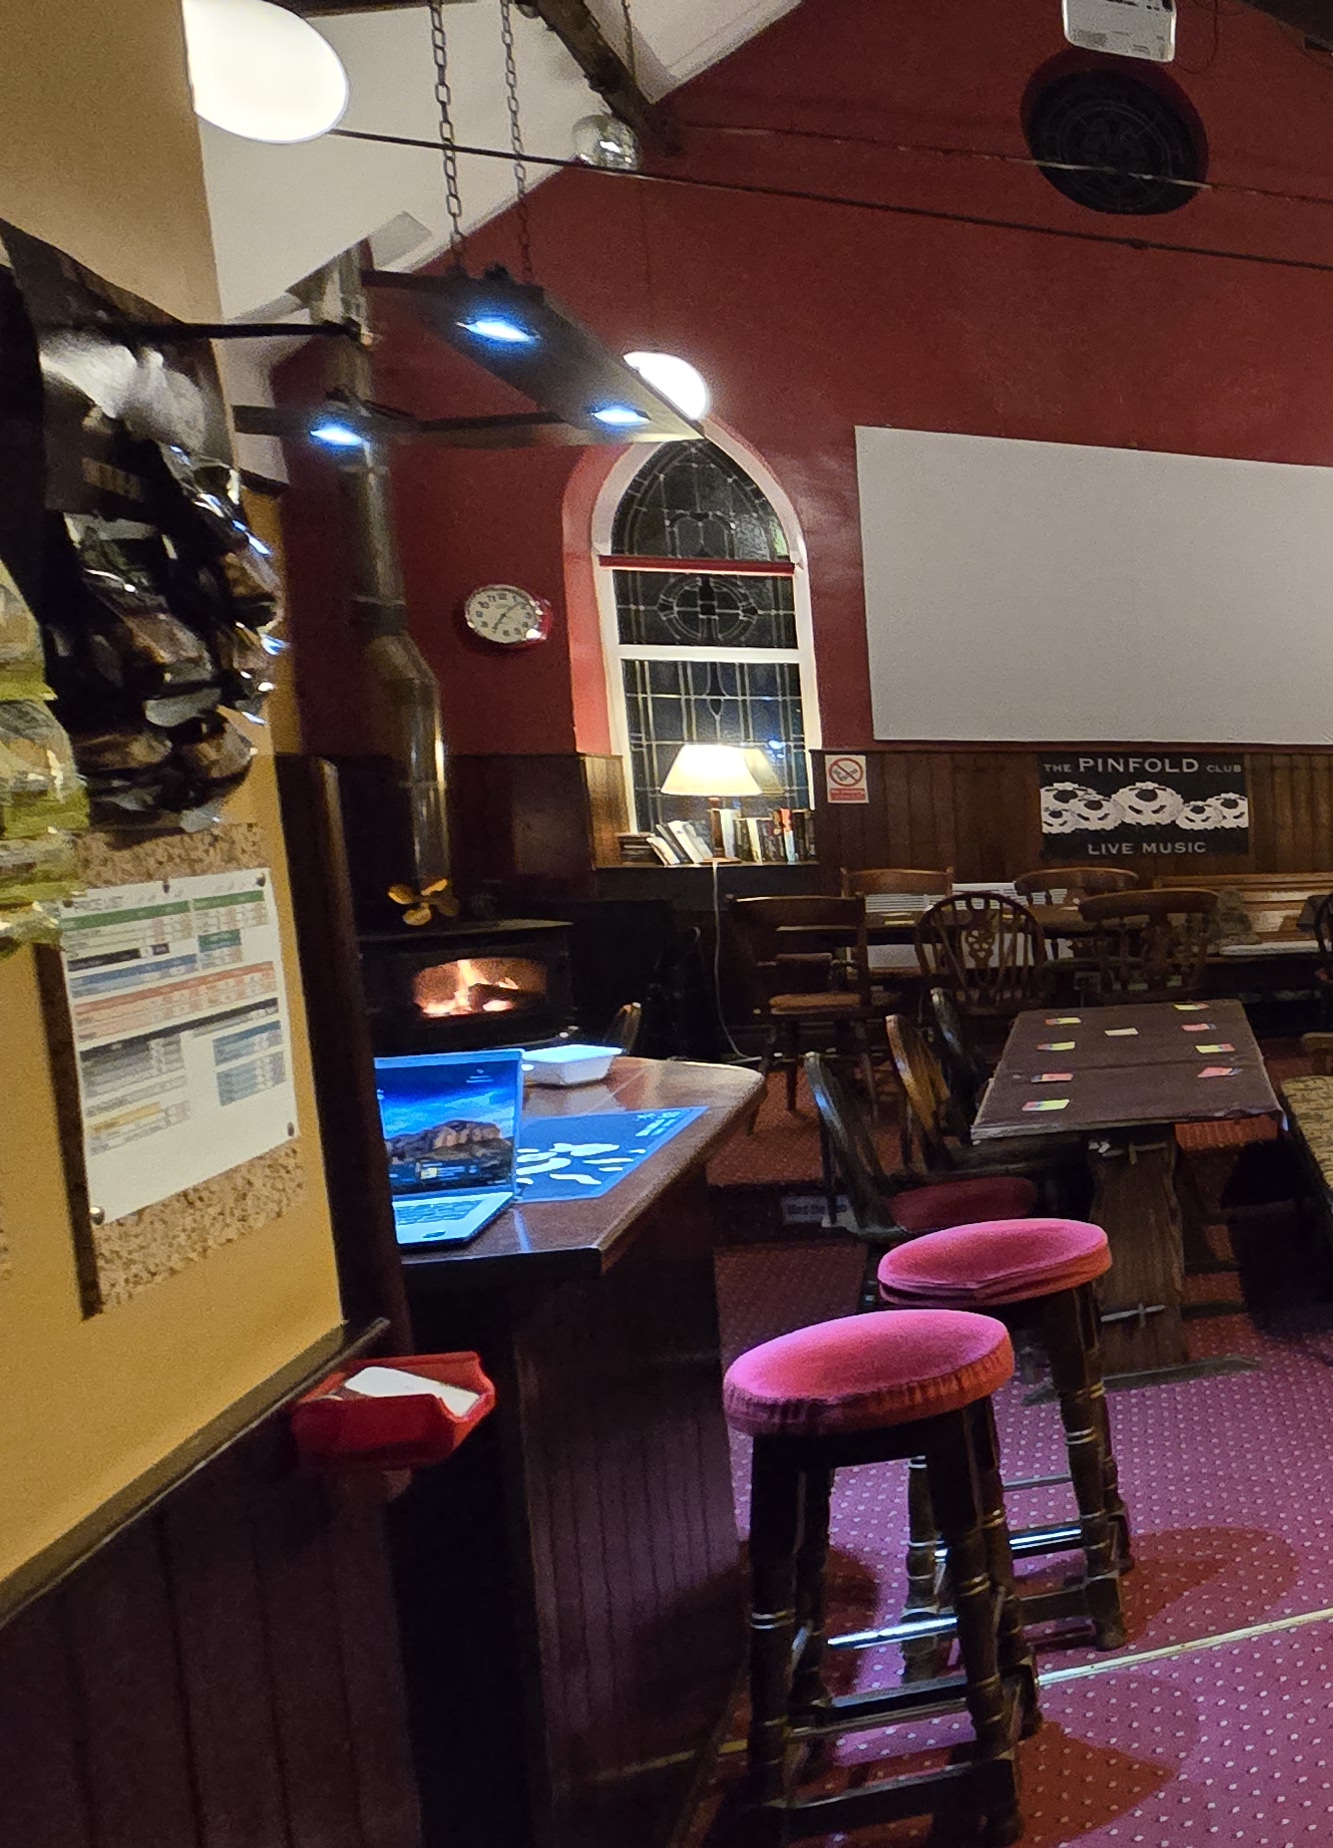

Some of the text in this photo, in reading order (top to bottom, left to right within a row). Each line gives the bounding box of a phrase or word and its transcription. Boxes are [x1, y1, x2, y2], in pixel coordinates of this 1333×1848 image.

[1044, 758, 1242, 773] THE PINFOLD CLUB
[1088, 841, 1207, 855] LIVE MUSIC
